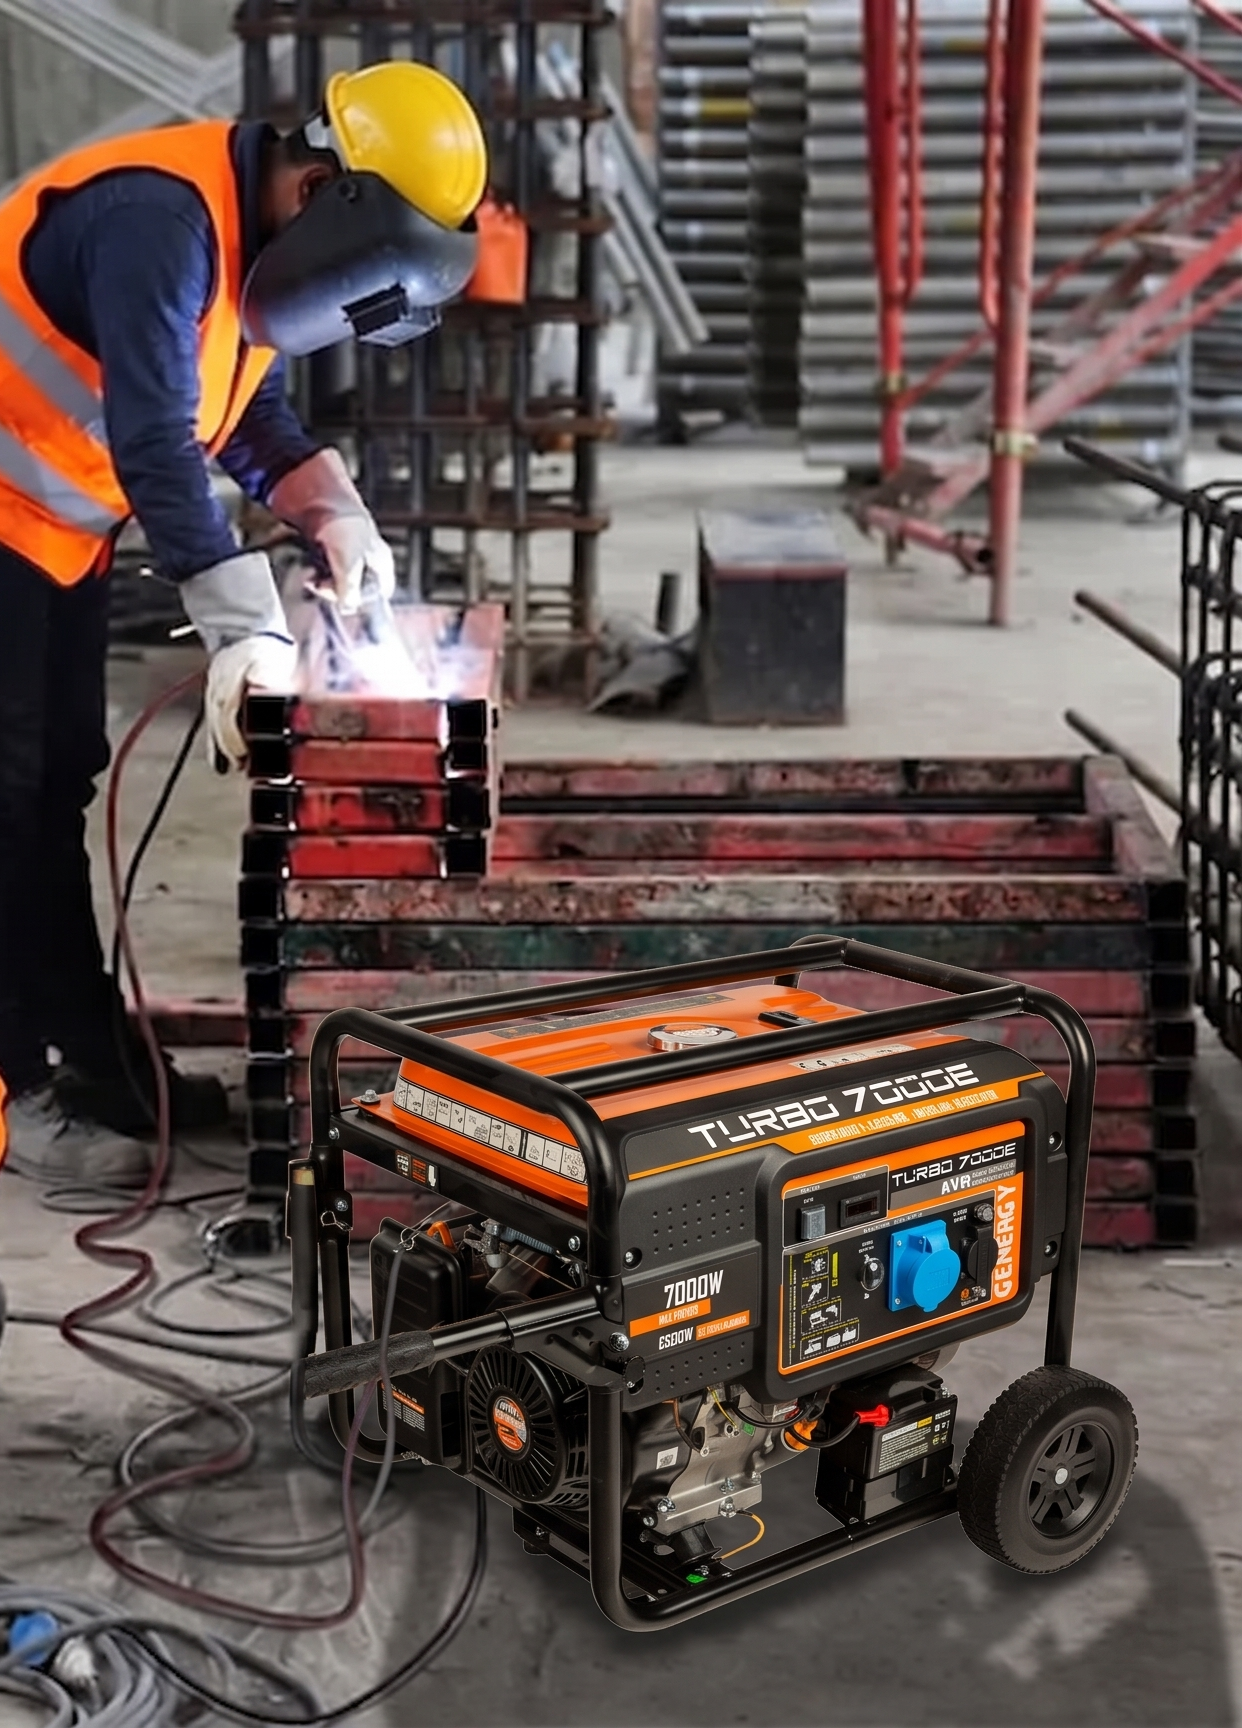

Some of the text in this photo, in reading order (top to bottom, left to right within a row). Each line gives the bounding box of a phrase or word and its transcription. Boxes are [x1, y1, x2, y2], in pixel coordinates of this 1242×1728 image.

[688, 1095, 840, 1149] TURBO
[841, 1062, 980, 1113] 7000E
[891, 1159, 953, 1187] TURBO
[958, 1142, 1017, 1170] 7000E
[941, 1174, 971, 1195] AVR
[994, 1185, 1017, 1299] GENERGY
[664, 1269, 724, 1309] 7000W
